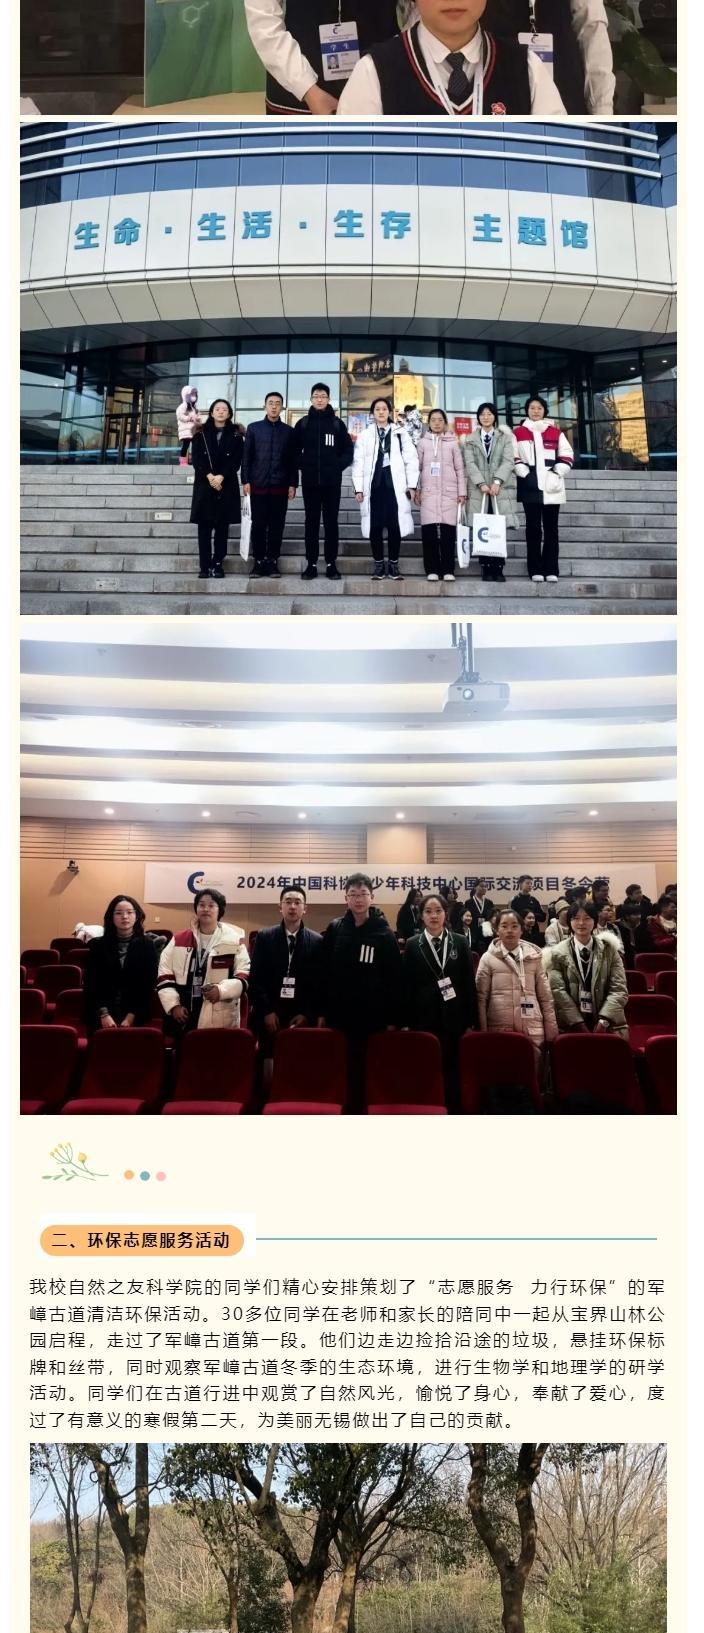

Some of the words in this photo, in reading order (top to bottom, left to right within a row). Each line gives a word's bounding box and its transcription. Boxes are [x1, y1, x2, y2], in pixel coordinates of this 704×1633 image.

[473, 211, 590, 251] 主题馆
[52, 1232, 229, 1248] 二、环保志愿服务活动
